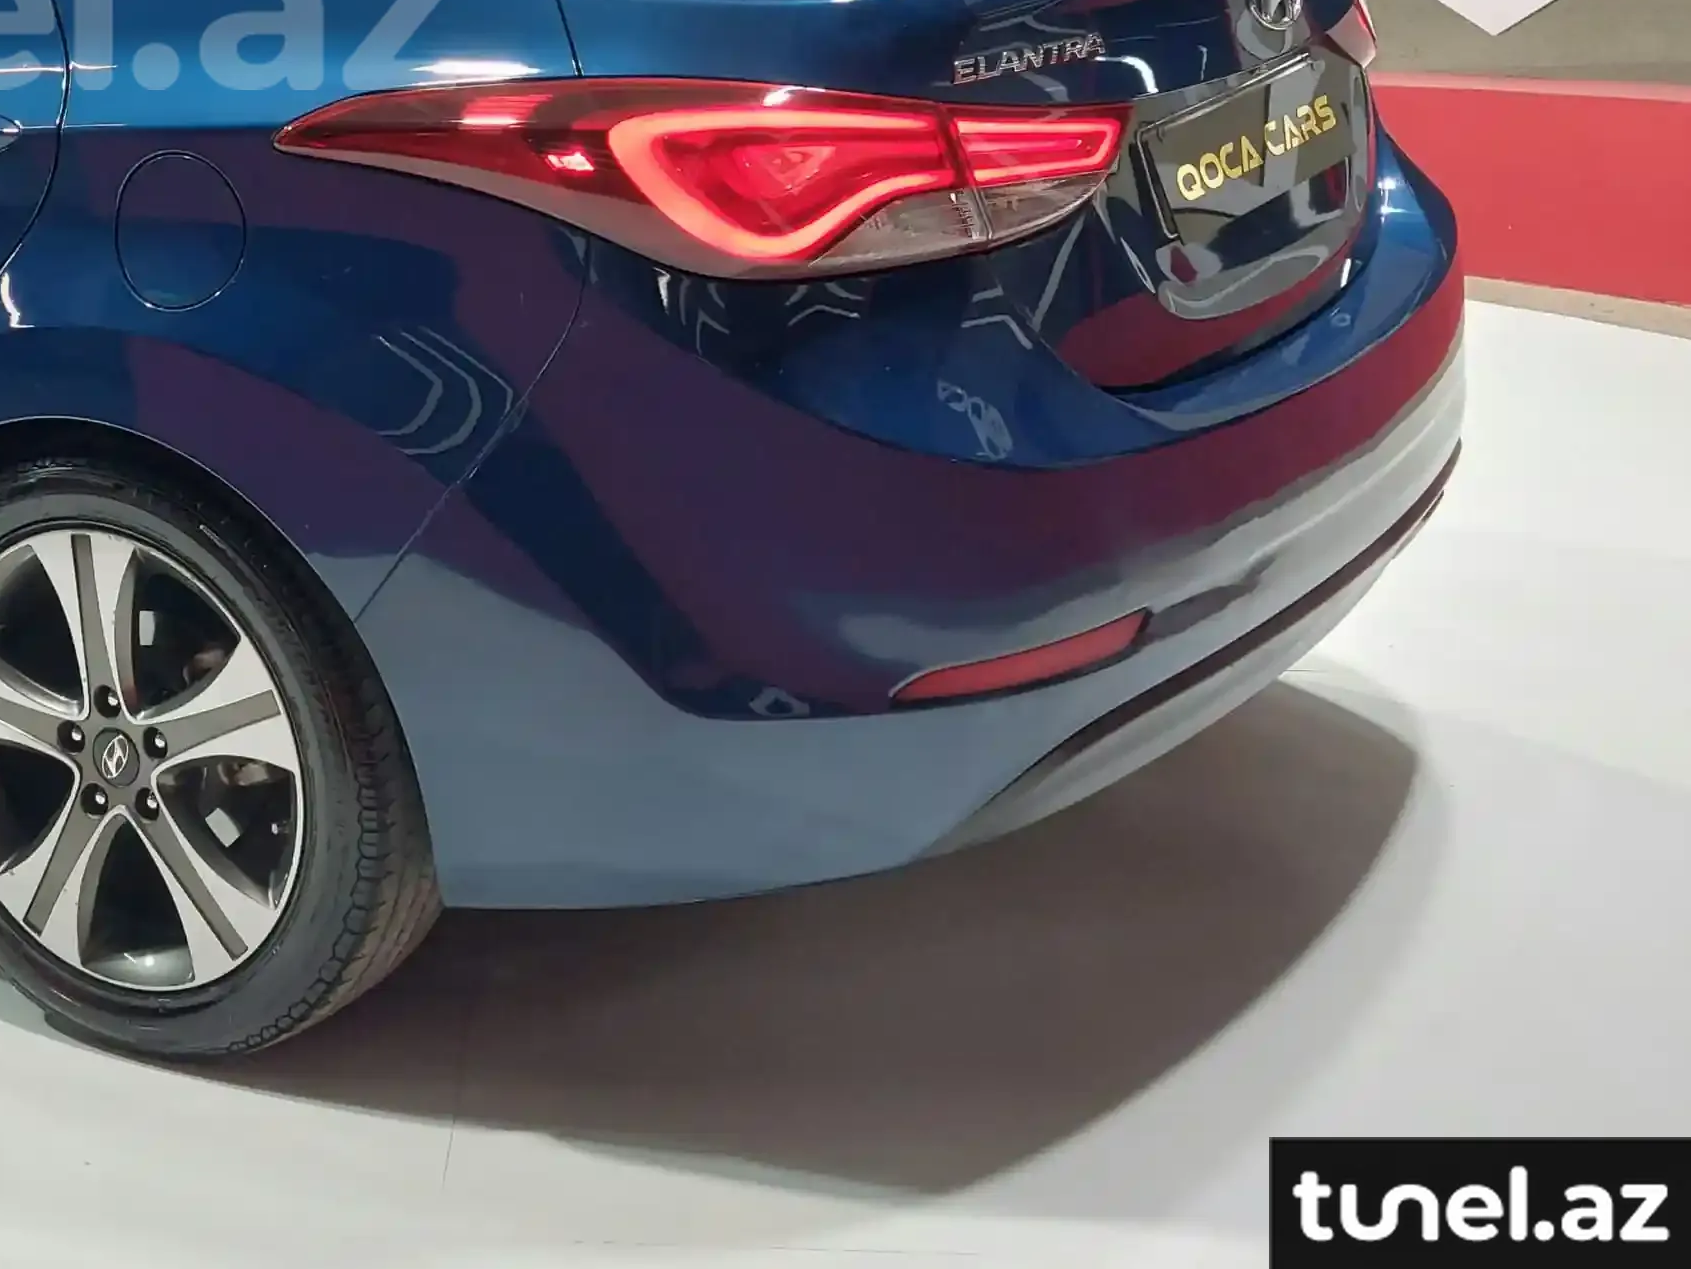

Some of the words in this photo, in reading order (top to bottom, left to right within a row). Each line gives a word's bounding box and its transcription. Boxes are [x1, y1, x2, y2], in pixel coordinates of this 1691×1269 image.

[953, 32, 1106, 84] ELANTRA
[1176, 135, 1264, 201] QOCA
[1264, 95, 1337, 156] CARS
